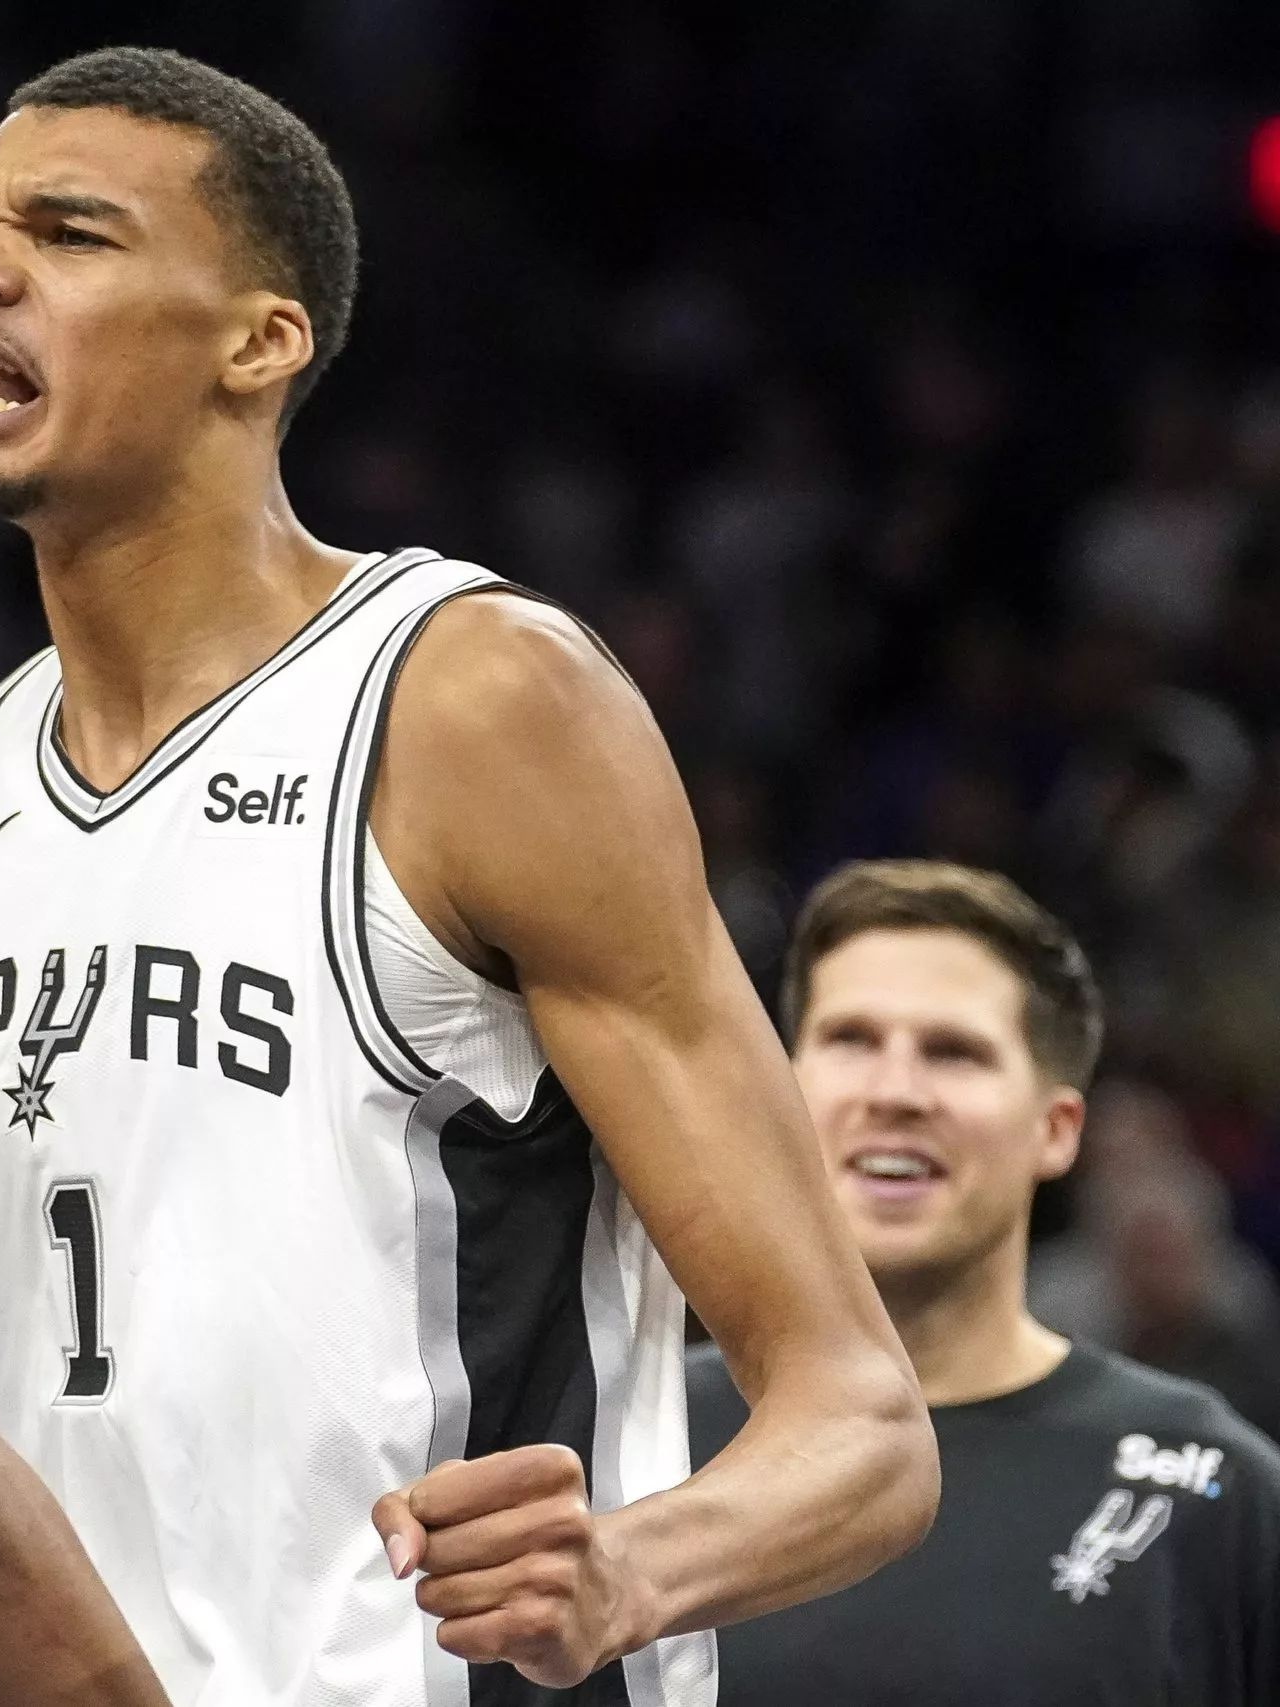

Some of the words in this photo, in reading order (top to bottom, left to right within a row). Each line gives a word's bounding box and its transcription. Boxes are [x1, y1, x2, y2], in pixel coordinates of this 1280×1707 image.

[203, 772, 309, 825] Self.
[42, 1173, 117, 1407] 1
[1114, 1433, 1224, 1499] Self.
